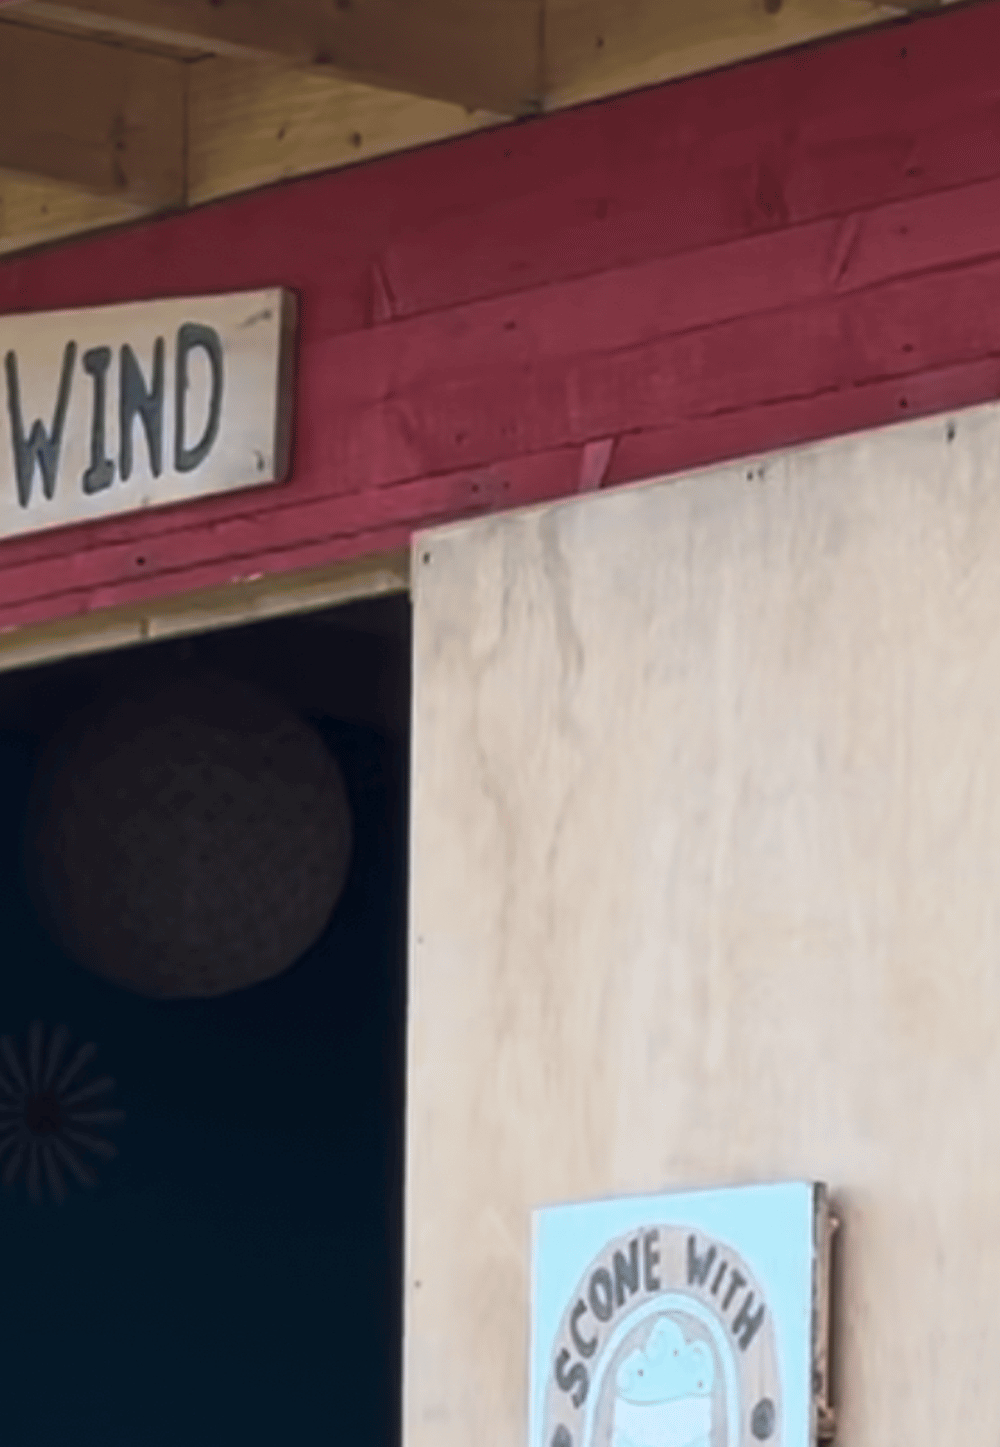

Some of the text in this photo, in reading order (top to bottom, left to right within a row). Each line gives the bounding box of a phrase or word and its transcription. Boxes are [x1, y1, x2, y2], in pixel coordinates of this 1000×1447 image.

[4, 321, 225, 508] WIND
[554, 1228, 765, 1409] SCONE WITH
